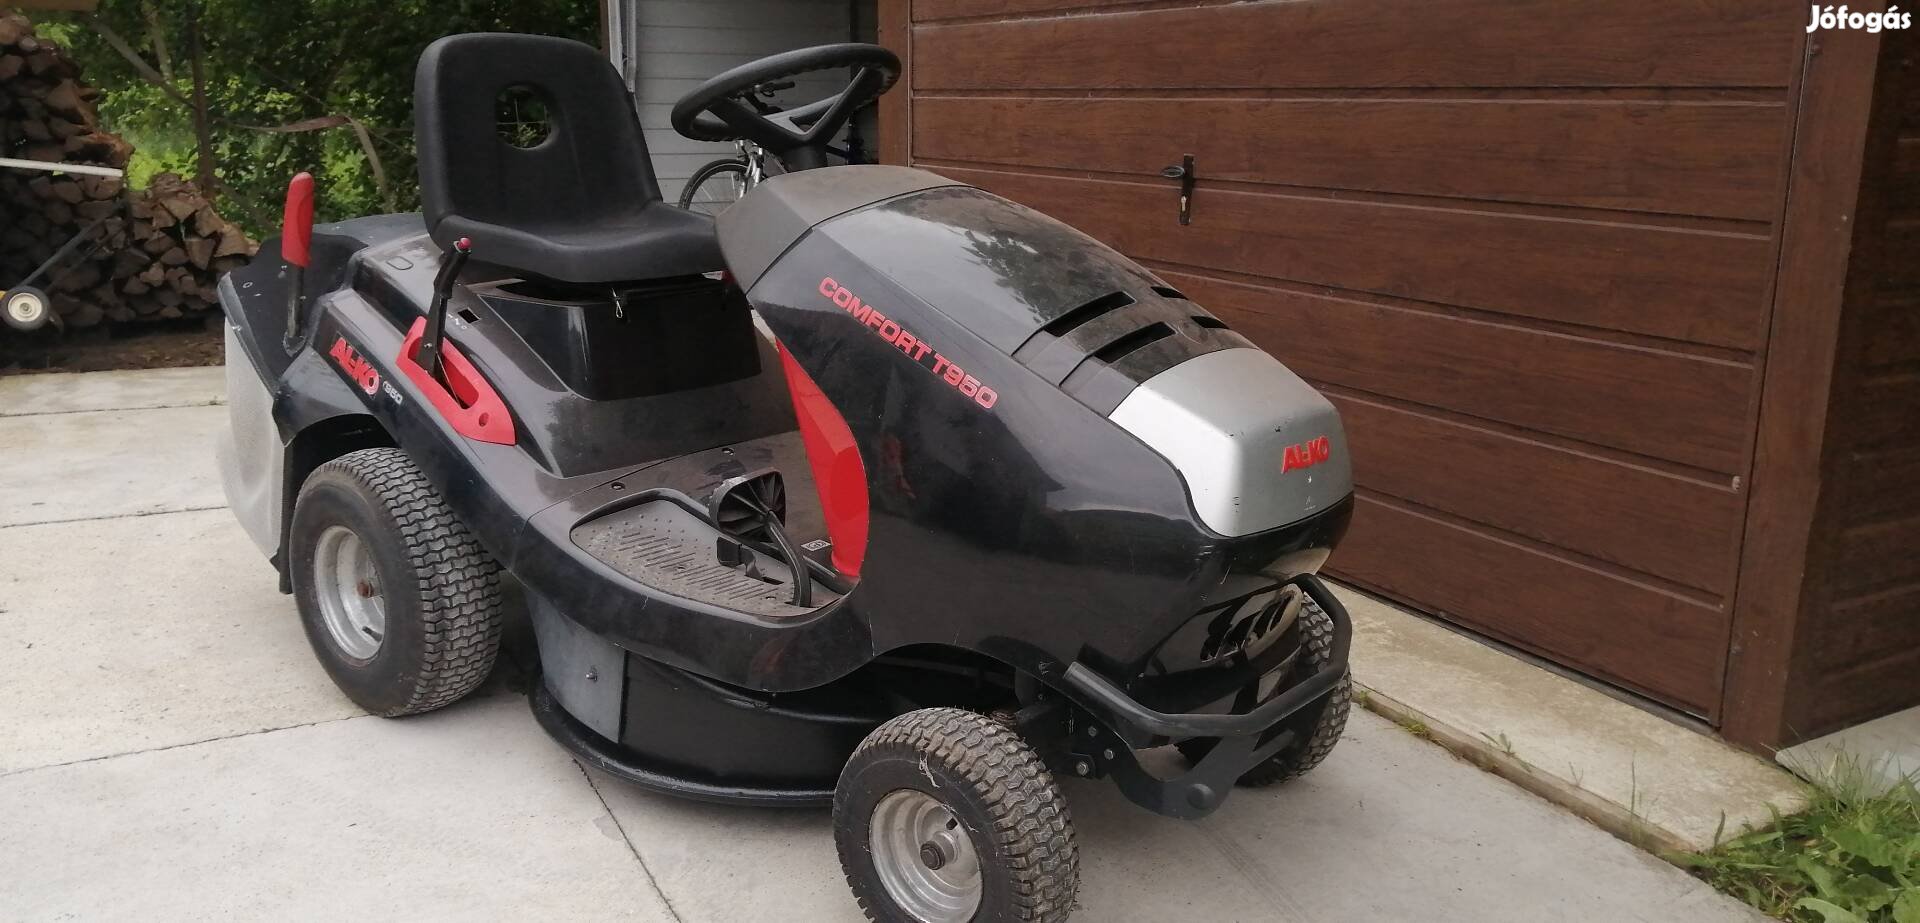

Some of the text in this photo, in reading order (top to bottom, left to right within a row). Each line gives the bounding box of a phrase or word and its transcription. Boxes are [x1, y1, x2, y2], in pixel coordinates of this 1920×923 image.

[329, 337, 380, 395] AL-KO
[818, 276, 998, 409] COMFORT T950
[1281, 435, 1330, 474] AL-KO
